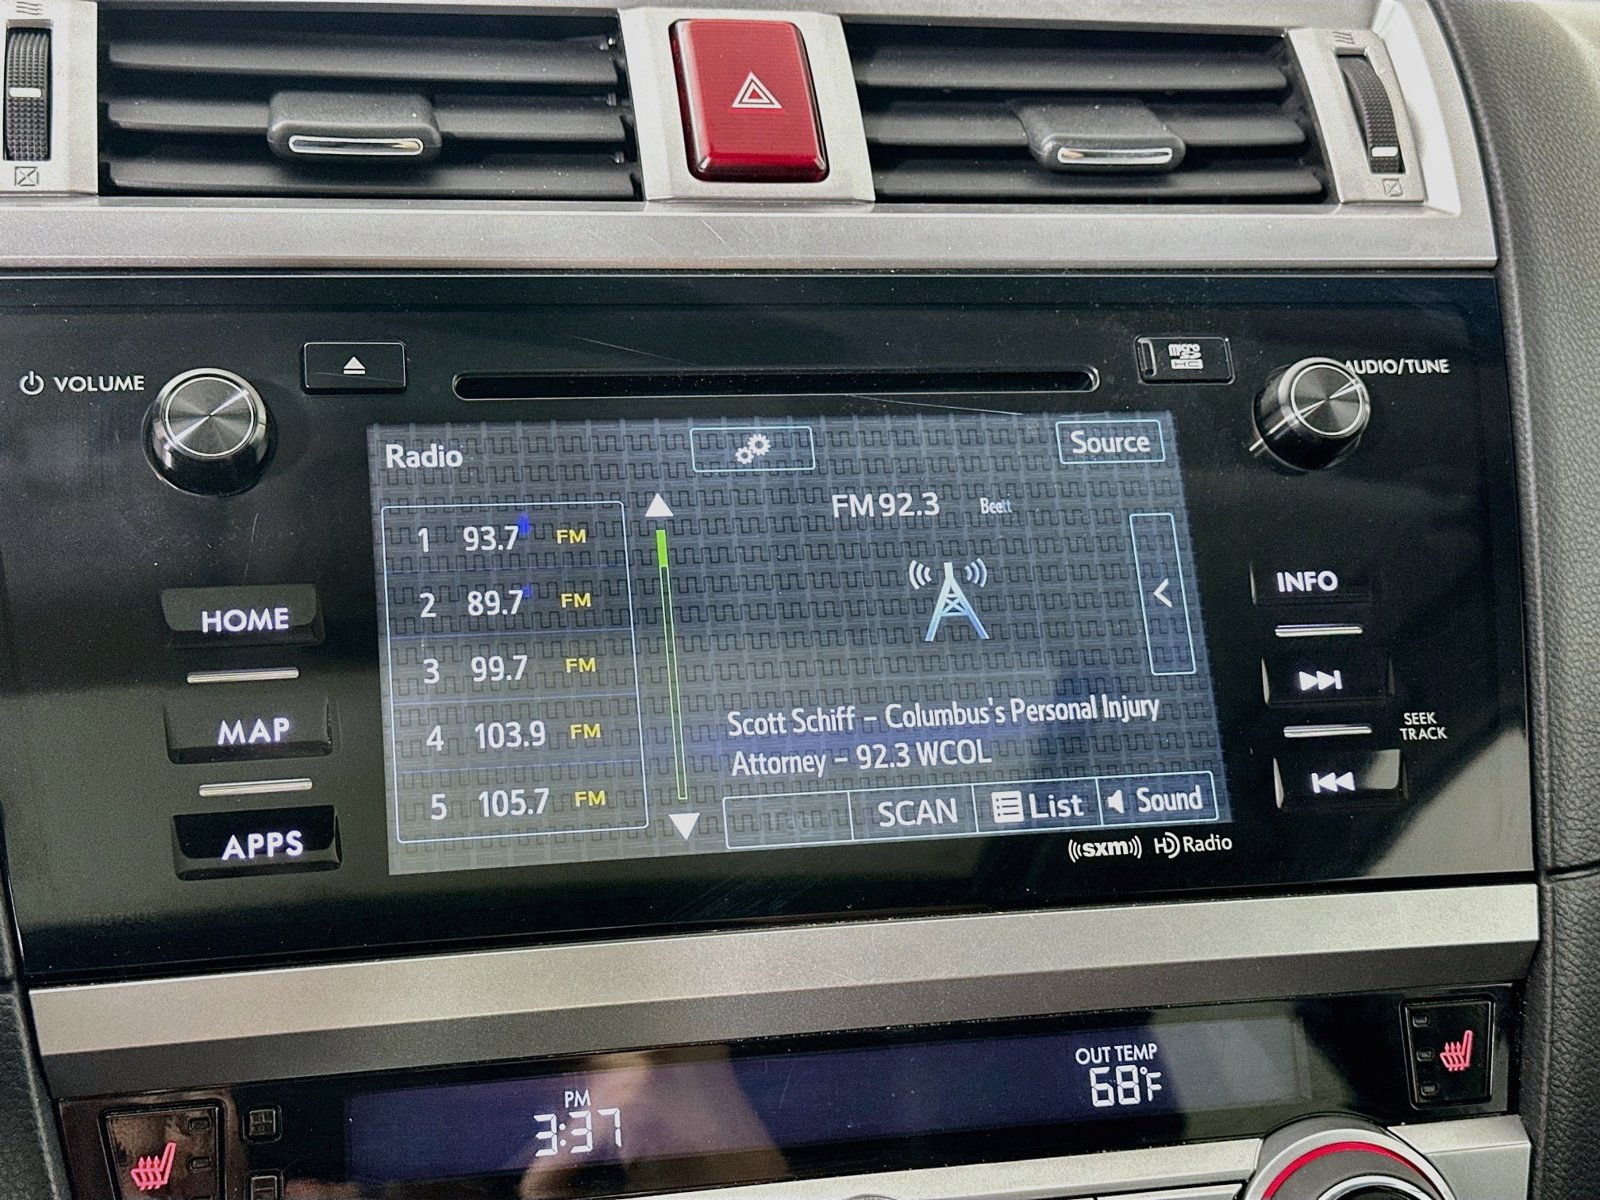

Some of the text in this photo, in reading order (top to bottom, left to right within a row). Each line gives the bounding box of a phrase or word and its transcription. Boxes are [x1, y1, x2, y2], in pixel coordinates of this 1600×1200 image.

[1345, 358, 1450, 375] AUDIO/TUNE
[53, 375, 145, 393] VOLUME
[385, 443, 463, 469] Radio
[1070, 430, 1151, 455] Source
[417, 525, 587, 553] 1 93.7 FM
[1276, 570, 1339, 593] INFO
[419, 590, 592, 619] 2 89.7 FM
[201, 607, 290, 633] HOME
[422, 655, 597, 684] 3 99.7 FM
[727, 710, 788, 737] Scott
[791, 705, 856, 734] Schiff
[885, 697, 1006, 729] Columbus's
[1009, 694, 1098, 723] Personal
[1101, 693, 1160, 723] Injury
[1403, 712, 1438, 726] SEEK
[217, 717, 290, 746] MAP
[426, 720, 601, 751] 4 103.9 FM
[1400, 726, 1448, 741] TRACK
[731, 751, 827, 778] Attorney
[856, 742, 911, 770] 92.3
[915, 738, 993, 767] WCOL
[430, 787, 606, 821] 5 105.7 FM
[1028, 792, 1085, 820] List
[1136, 784, 1204, 813] Sound
[877, 798, 958, 828] SCAN
[221, 830, 304, 861] APPS
[1182, 833, 1233, 853] Radio
[1075, 1043, 1158, 1065] OUT TEMP
[564, 1088, 592, 1108] PM
[533, 1107, 622, 1157] 3:37
